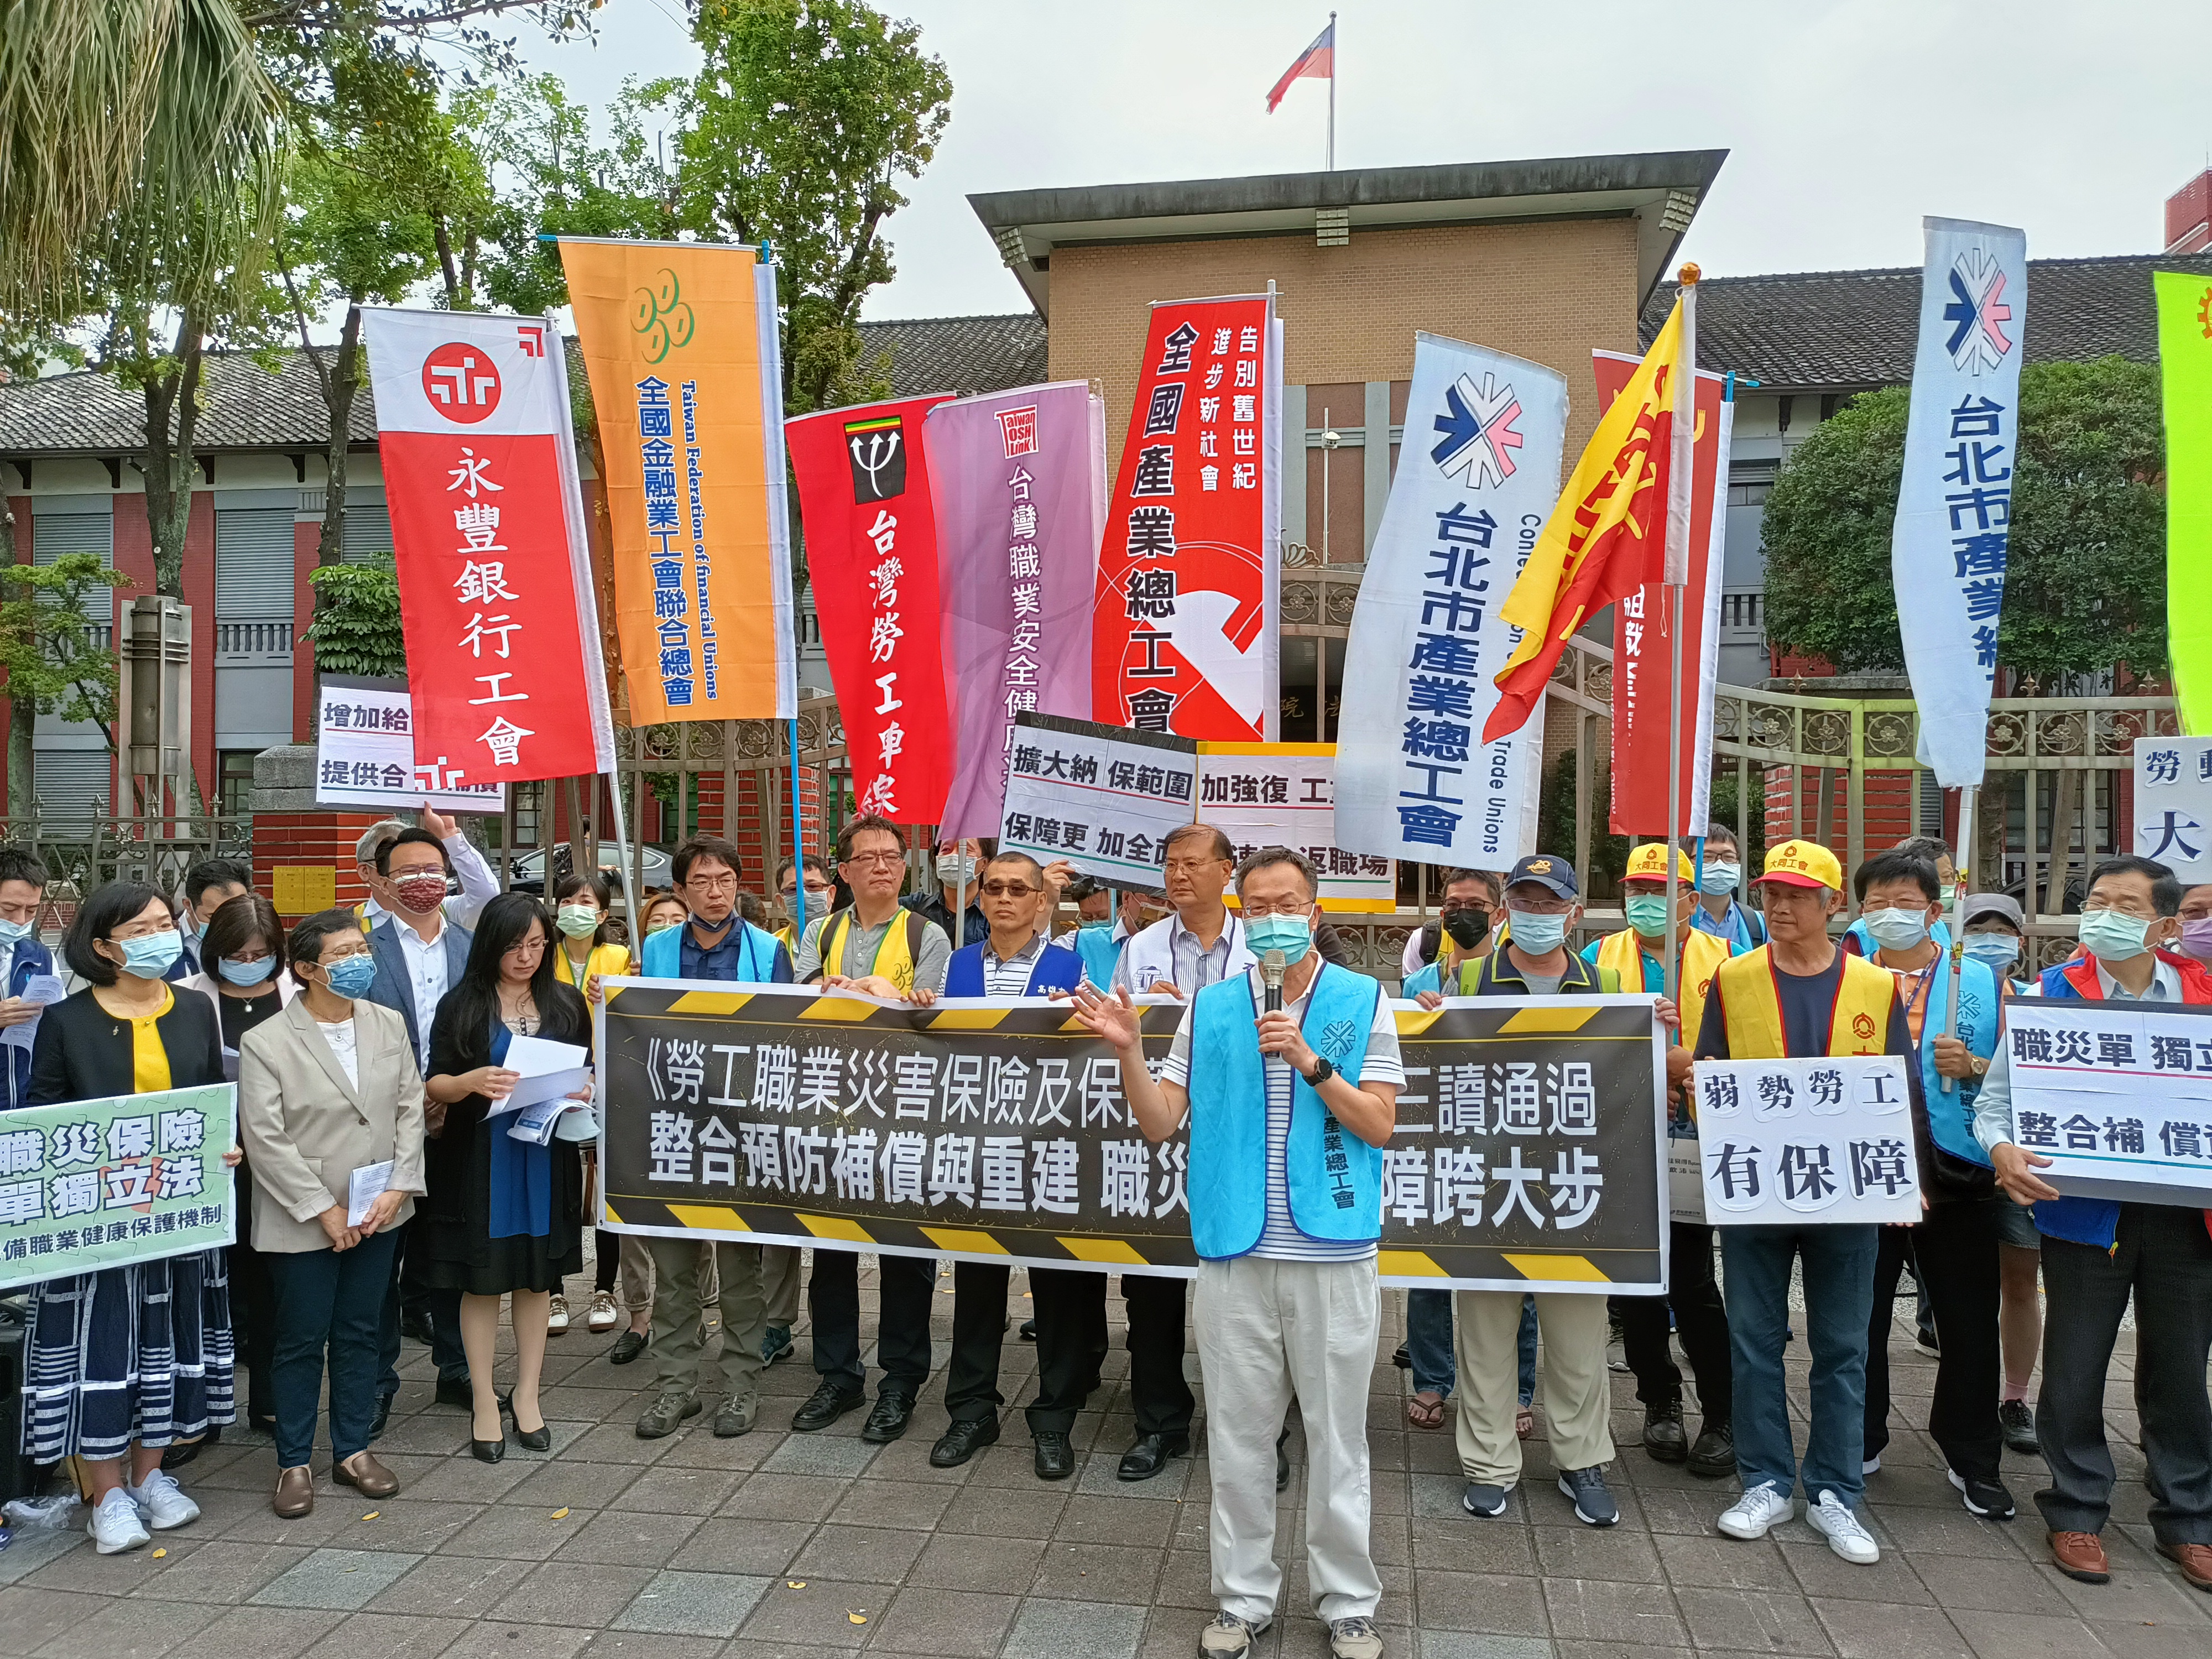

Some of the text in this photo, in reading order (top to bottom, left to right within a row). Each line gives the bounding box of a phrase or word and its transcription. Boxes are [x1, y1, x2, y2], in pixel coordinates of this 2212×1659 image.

[1009, 425, 1031, 442] OSH
[1199, 327, 1232, 492] 進步新社會
[1232, 325, 1258, 489] 告別舊世紀
[635, 375, 694, 706] 全國金融業工會聯合總會
[680, 379, 718, 701] Taiwan Federation of financial Unions
[1124, 320, 1199, 733] 全國產業總工會
[1942, 394, 2011, 681] 台北市產業
[446, 447, 535, 766] 永豐銀行工會
[999, 465, 1041, 807] 台灣職業安全健
[1396, 501, 1499, 848] 台北市產業總工會
[324, 702, 410, 732] 增加給
[1201, 773, 1334, 804] 加強復工
[1489, 741, 1511, 790] Trade
[1483, 797, 1506, 853] Unions
[2143, 811, 2203, 860] 大
[1635, 860, 1668, 872] 大同工會
[1769, 858, 1809, 871] 大同工會
[1703, 1070, 1900, 1112] 弱勢勞工
[0, 1108, 207, 1176] 職災保險
[648, 1109, 1080, 1214] 整合預防補償與重建
[2018, 1110, 2212, 1160] 整合補償
[0, 1155, 205, 1227] 單獨立法
[1707, 1139, 1912, 1201] 有保障
[0, 1203, 222, 1261] 備職業健康保護機制
